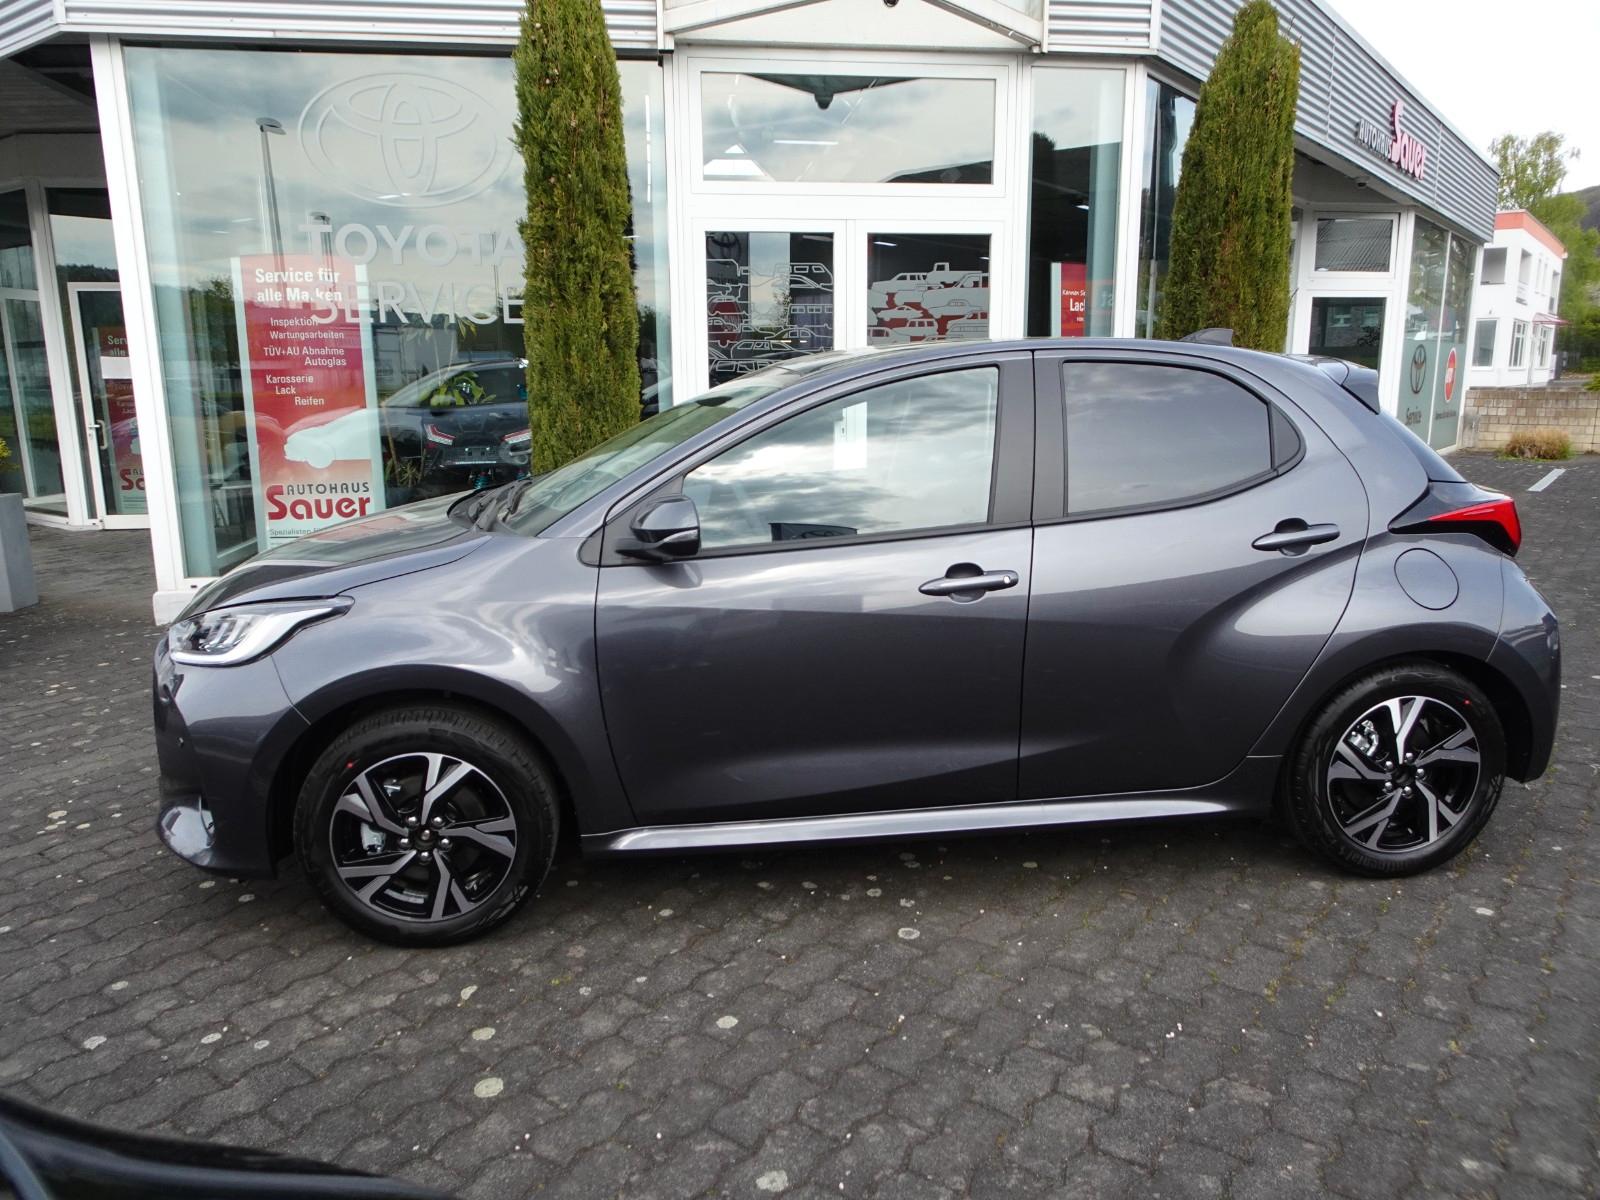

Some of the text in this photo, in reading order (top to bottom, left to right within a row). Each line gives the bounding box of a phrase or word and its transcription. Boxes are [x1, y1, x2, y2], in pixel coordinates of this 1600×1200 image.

[1359, 100, 1424, 180] AUTOHAUS Sauer
[299, 223, 526, 268] TOYOTA
[255, 267, 340, 284] Service für
[257, 287, 282, 302] alle
[308, 281, 525, 325] SERVICE
[270, 317, 319, 327] Inspektion
[269, 330, 345, 341] Wartungsarbeiten
[263, 345, 345, 356] TÜV+AU Abnahme
[304, 357, 347, 368] Autoglas
[266, 374, 314, 384] Karosserie
[275, 385, 296, 395] Lack
[294, 396, 325, 406] Reifen
[287, 482, 370, 496] AUTOHAUS
[266, 484, 371, 521] Sauer
